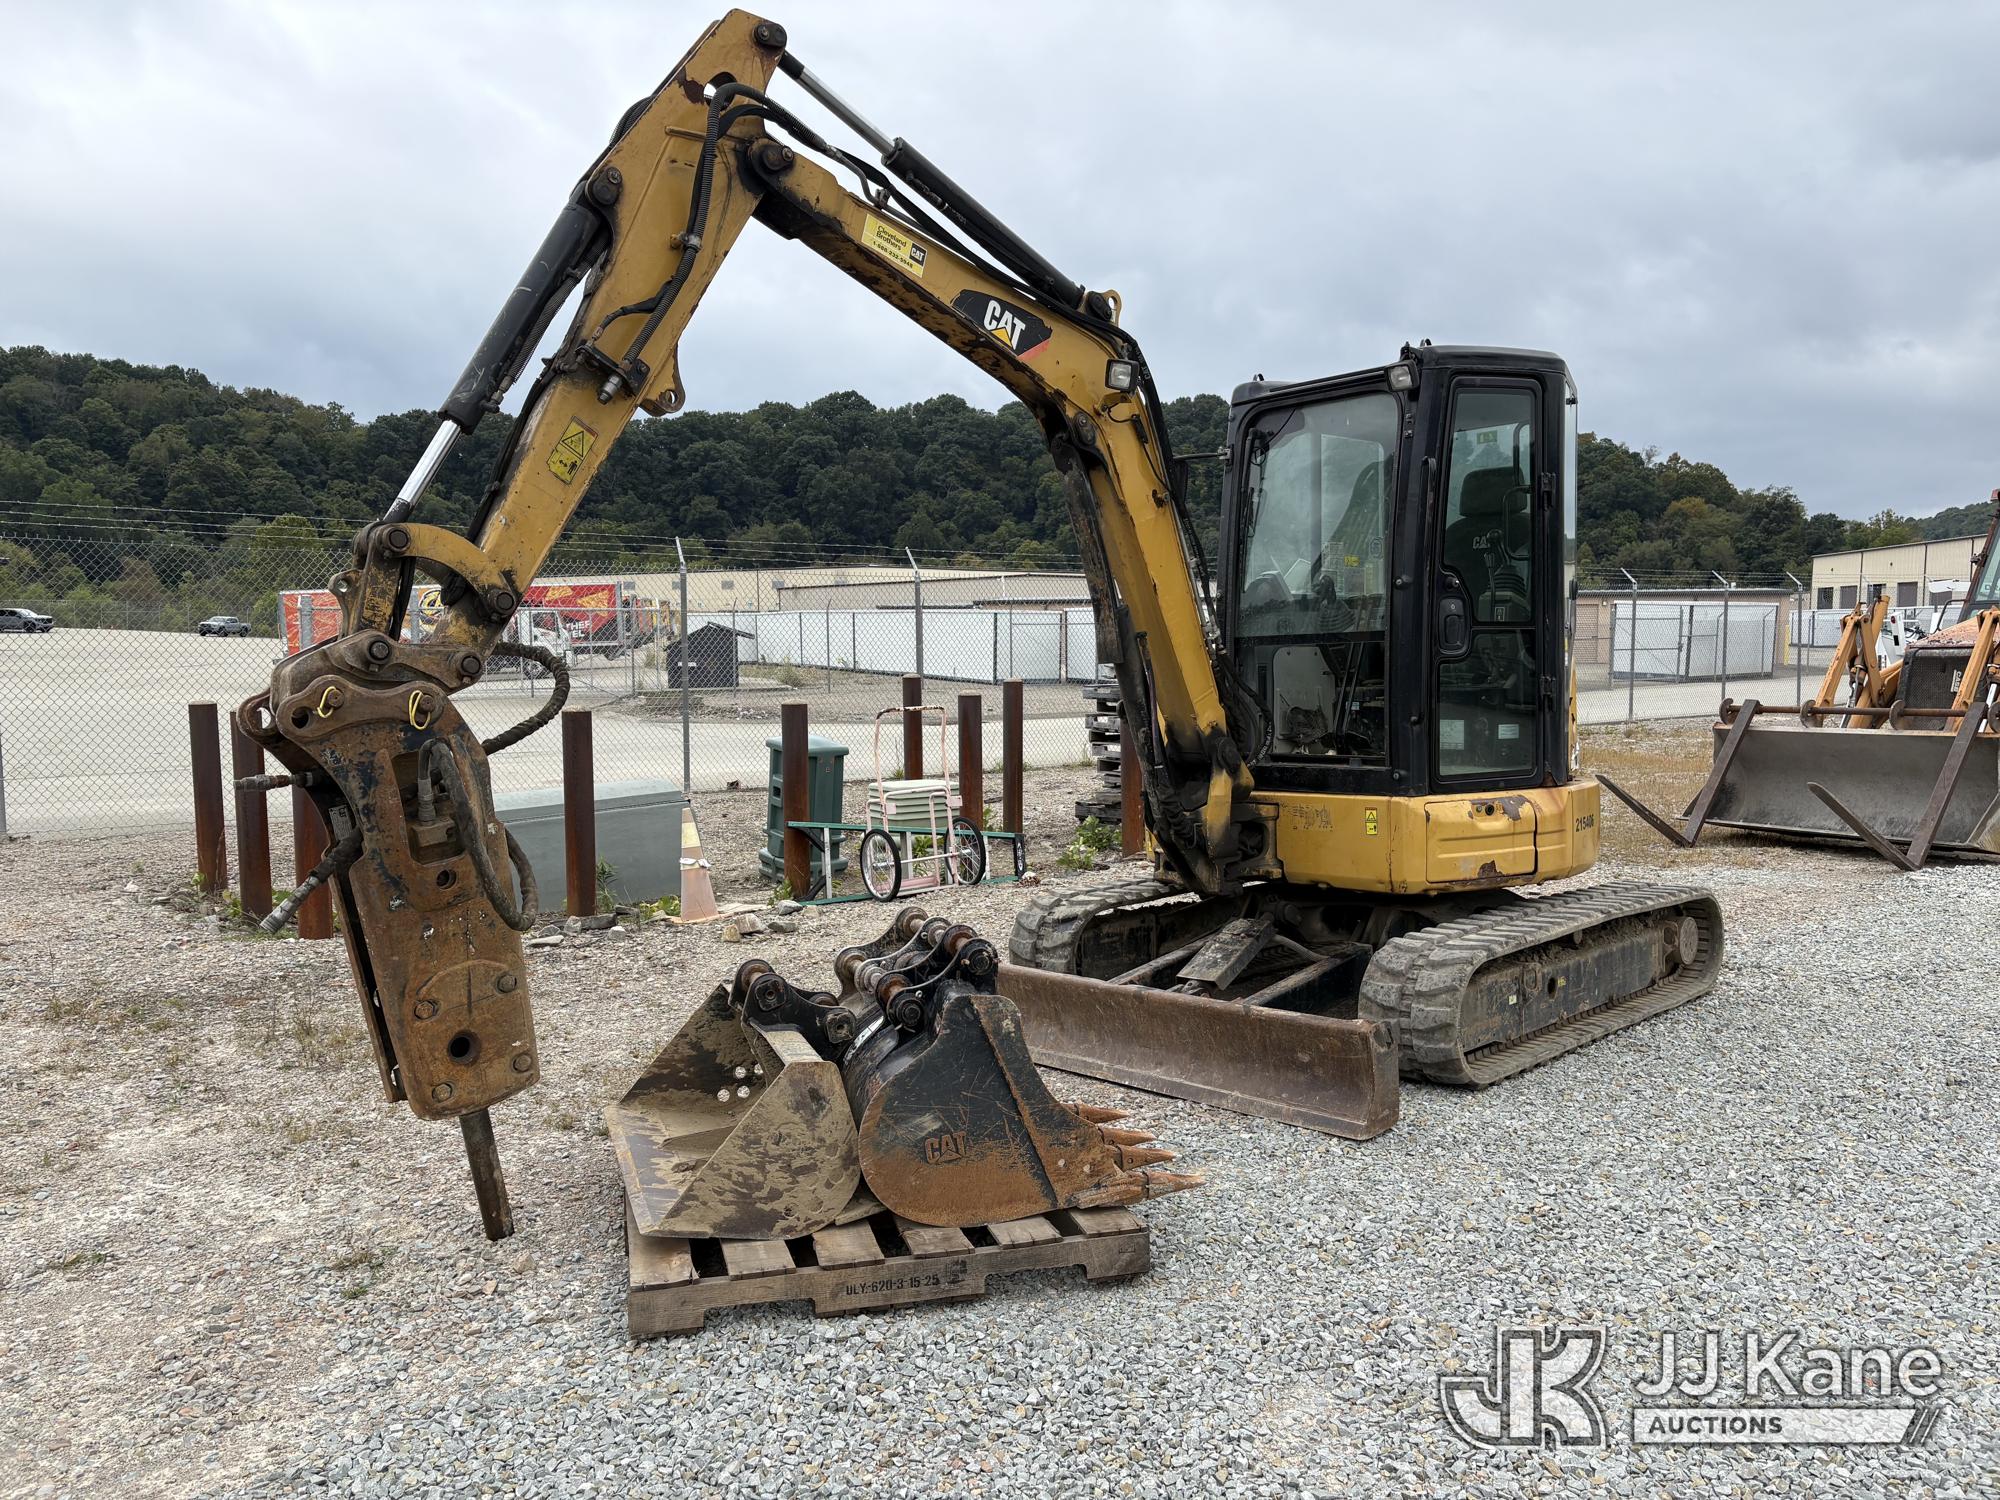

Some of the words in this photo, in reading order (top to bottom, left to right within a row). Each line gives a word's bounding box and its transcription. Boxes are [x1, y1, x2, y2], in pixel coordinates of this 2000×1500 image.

[876, 230, 902, 251] Brothers
[877, 225, 907, 247] Cleveland
[911, 247, 925, 262] CAT
[983, 300, 1026, 350] CAT
[1472, 535, 1491, 550] CA
[924, 1131, 967, 1165] CAT
